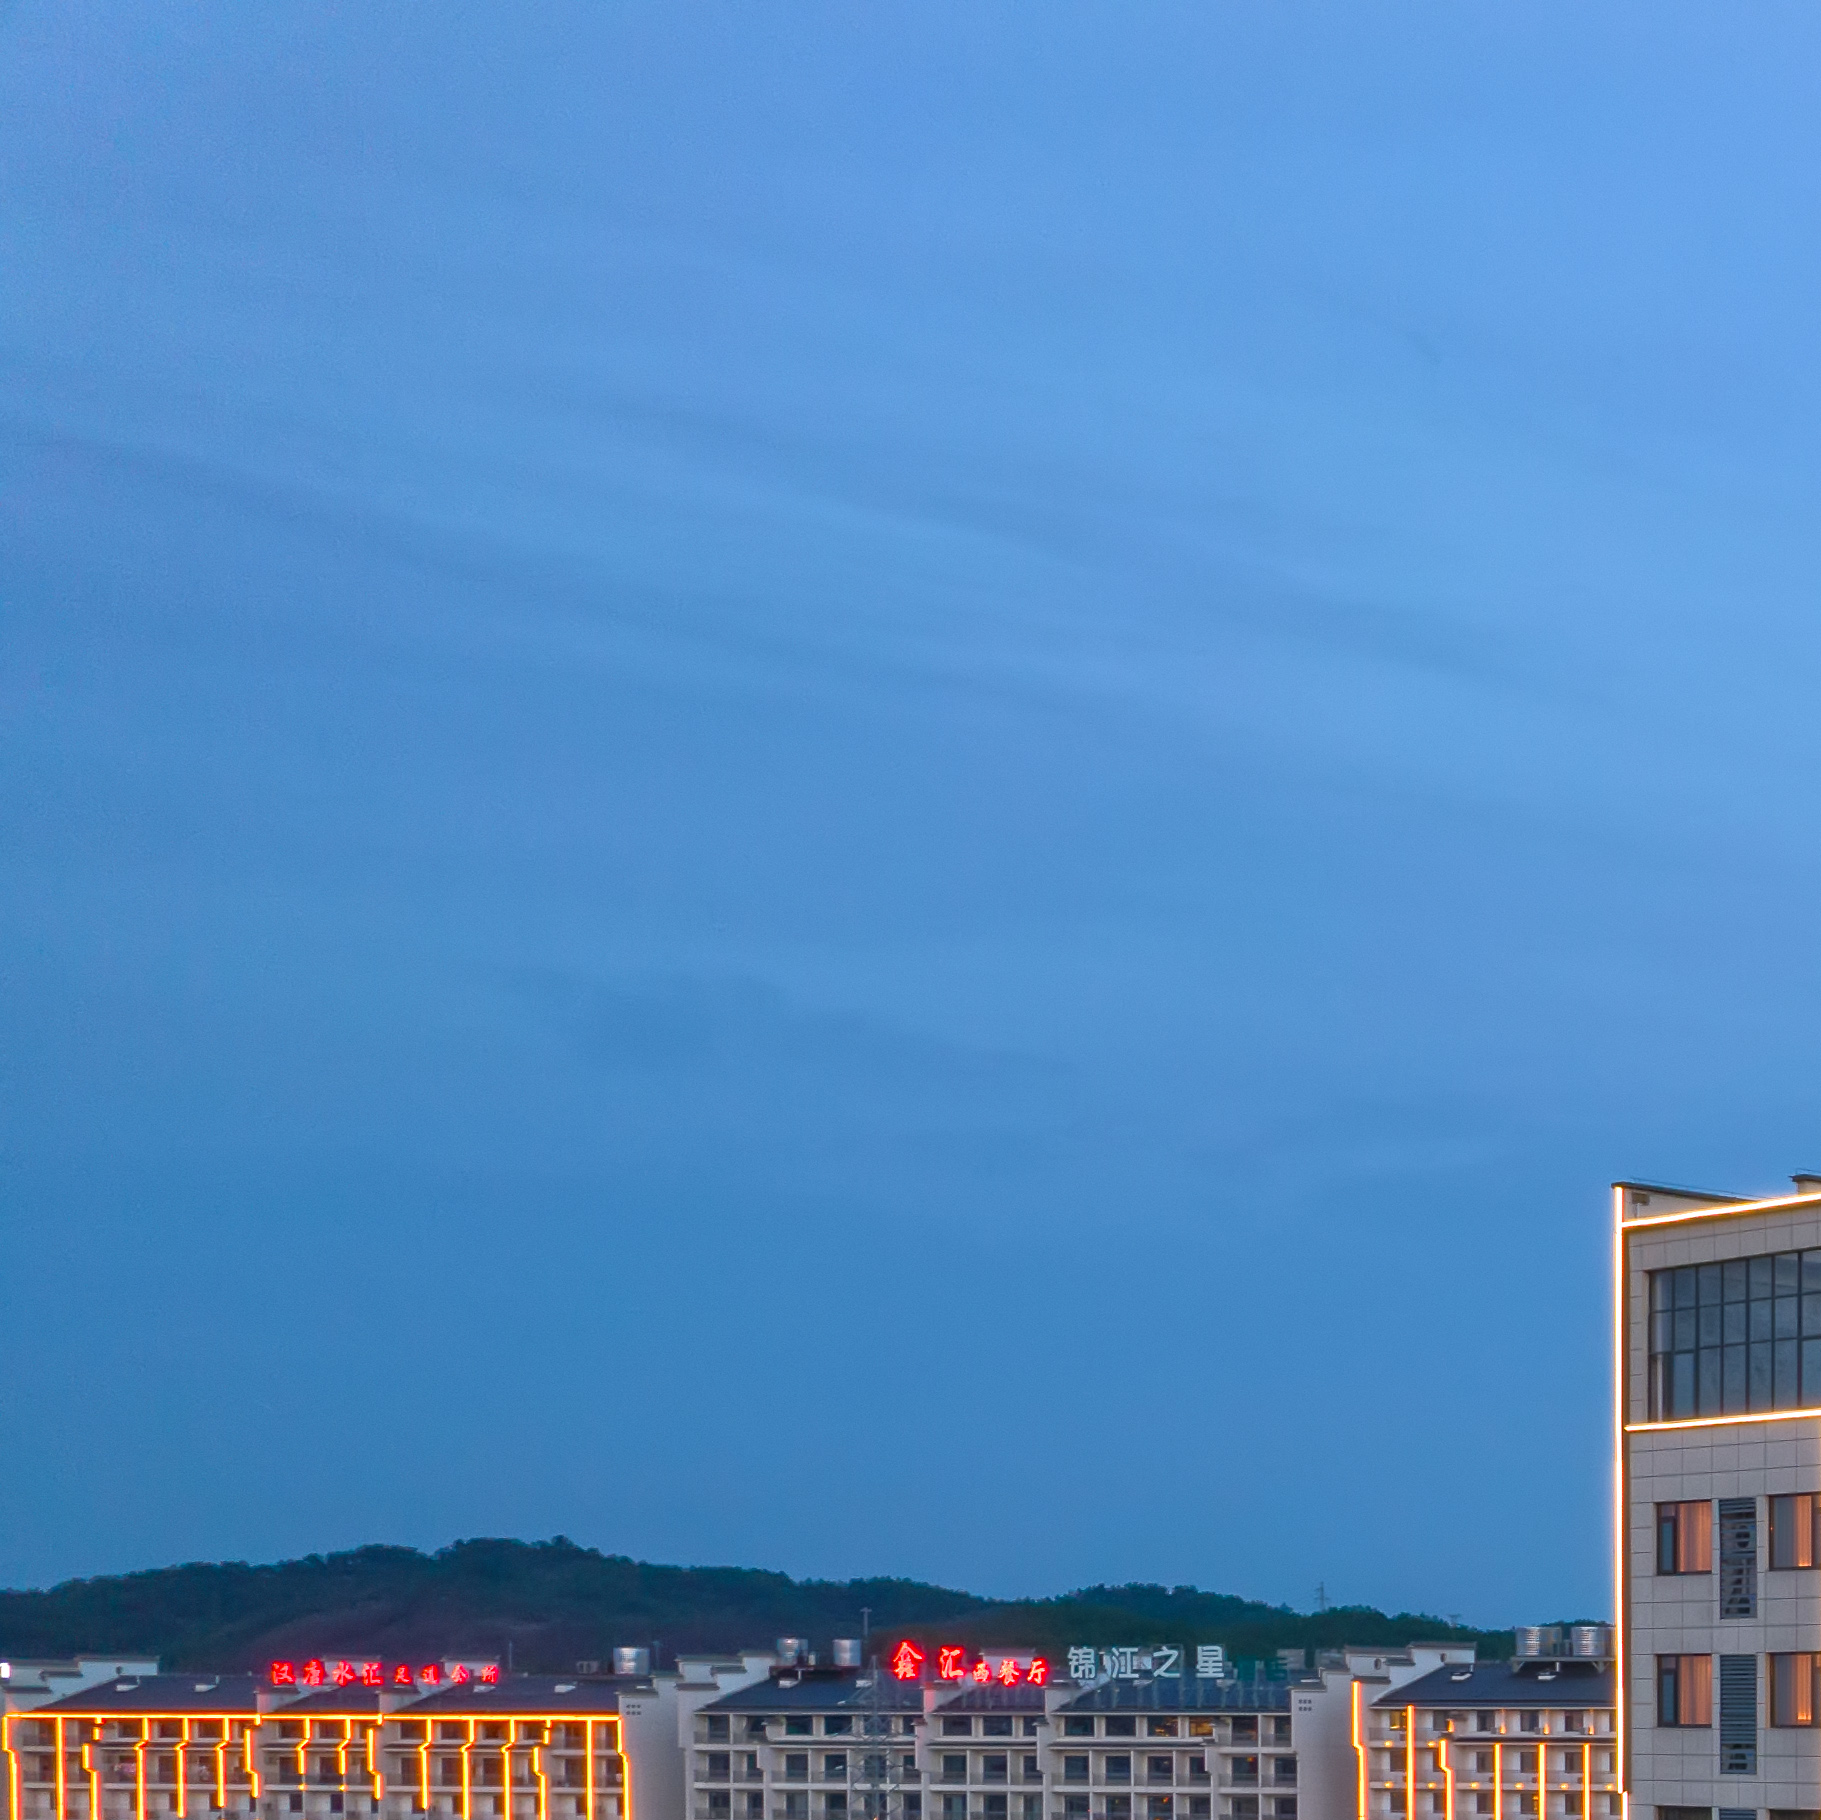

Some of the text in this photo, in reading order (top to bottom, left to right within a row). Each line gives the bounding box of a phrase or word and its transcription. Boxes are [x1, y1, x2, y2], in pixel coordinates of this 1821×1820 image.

[893, 1640, 1048, 1686] 鑫汇西餐厅
[1067, 1645, 1227, 1680] 锦江之星
